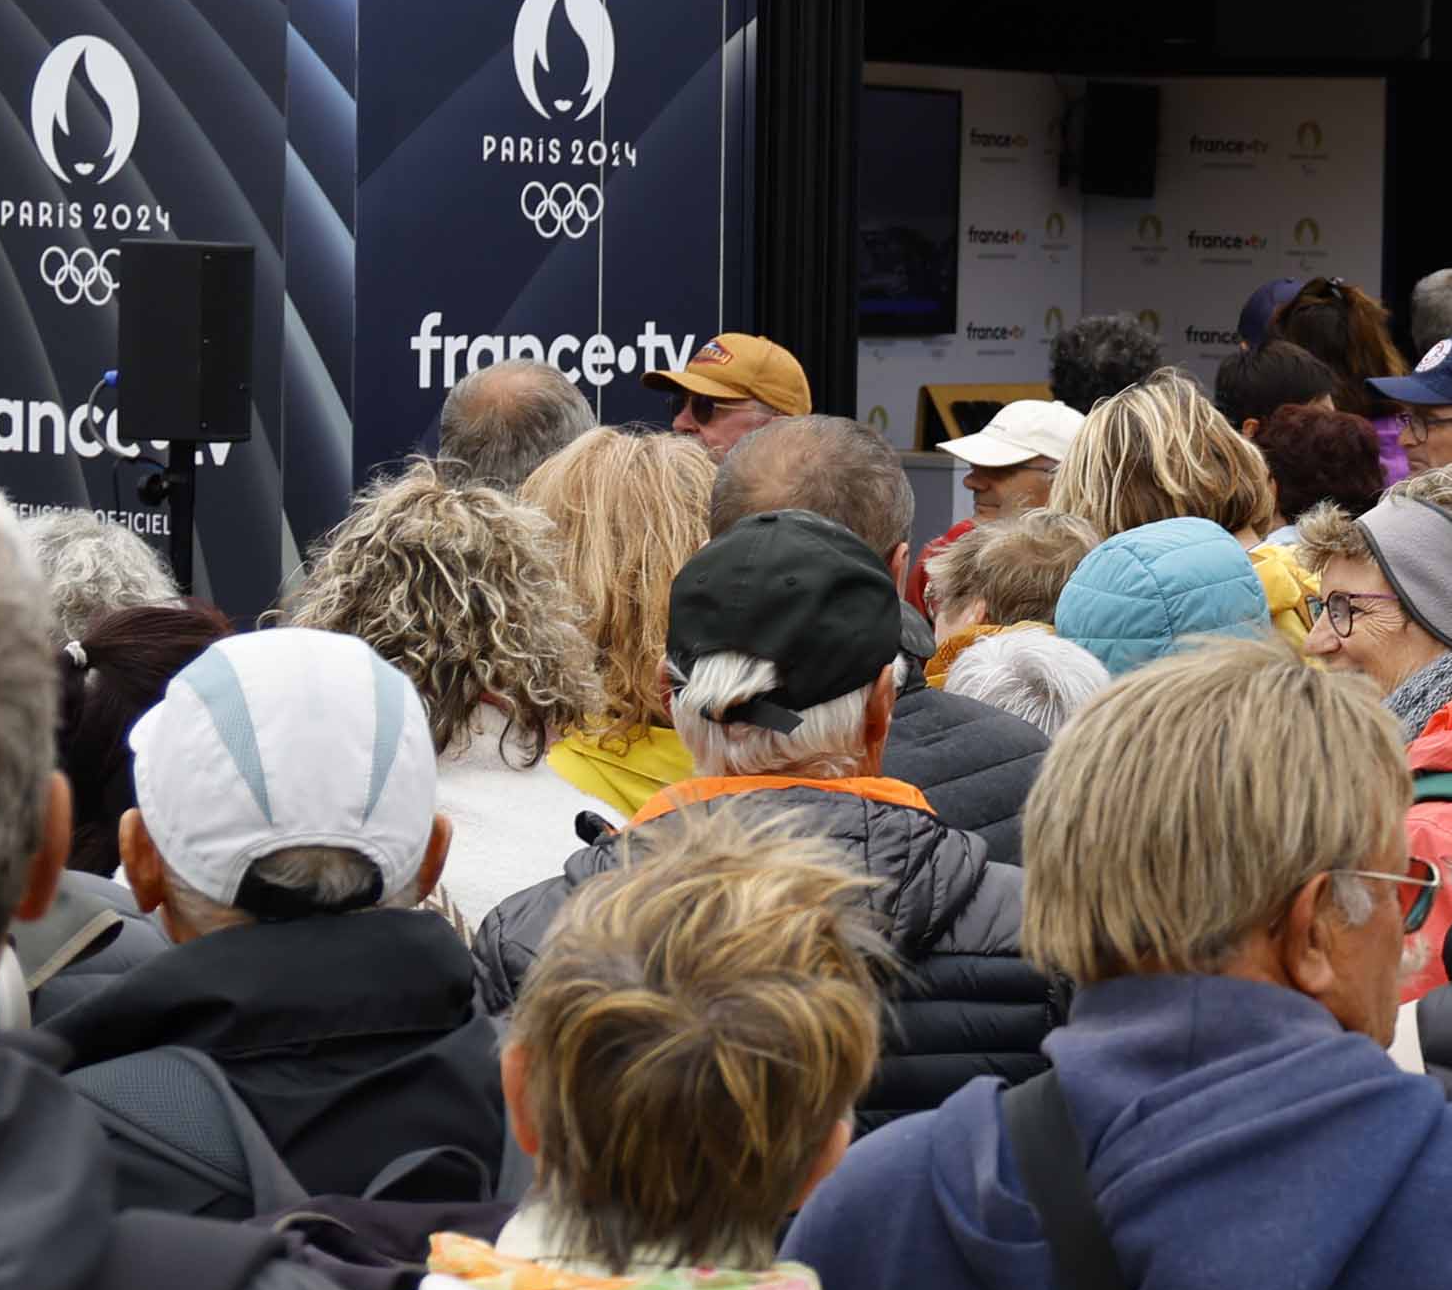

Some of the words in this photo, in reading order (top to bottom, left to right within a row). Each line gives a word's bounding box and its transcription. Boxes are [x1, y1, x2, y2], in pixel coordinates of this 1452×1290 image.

[482, 135, 561, 166] PARIS
[571, 139, 637, 168] 2024
[0, 200, 83, 229] PARIS
[93, 203, 170, 232] 2024
